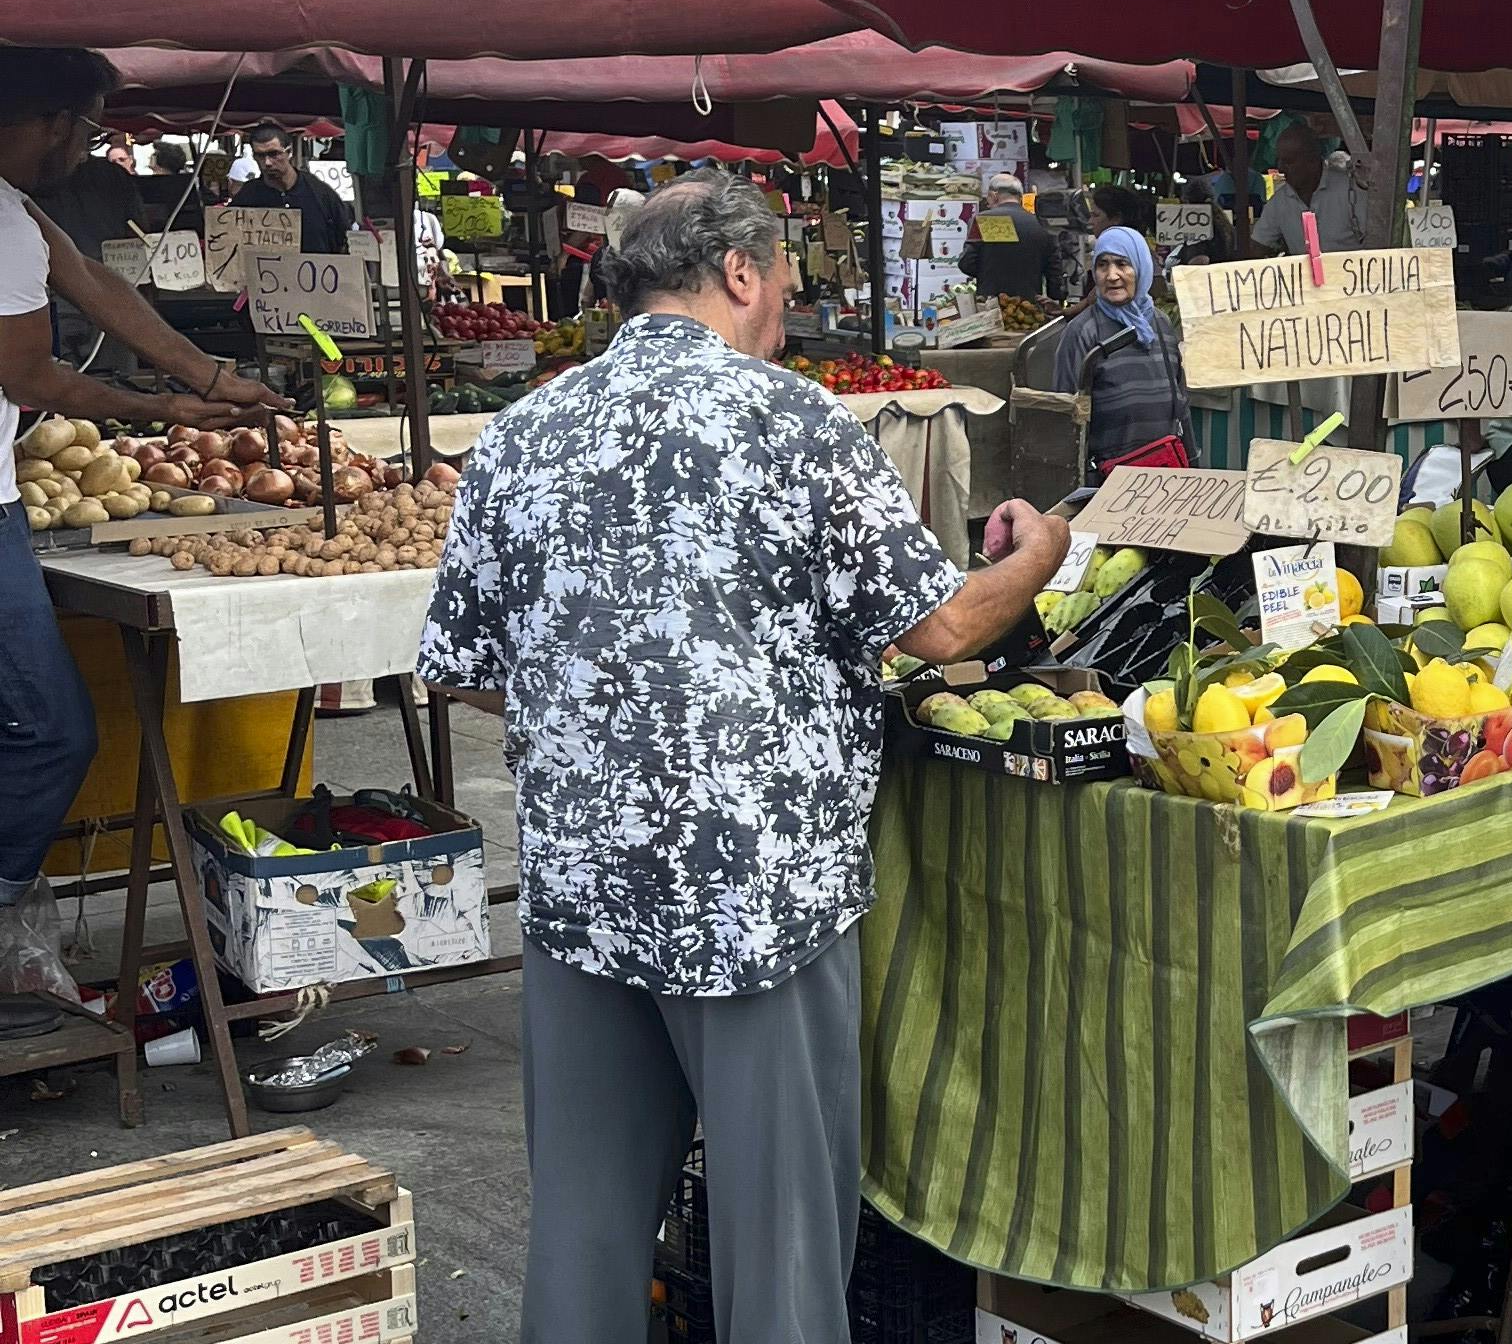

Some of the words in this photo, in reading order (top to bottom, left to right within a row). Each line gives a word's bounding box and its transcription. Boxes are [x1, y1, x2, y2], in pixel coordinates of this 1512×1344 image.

[255, 256, 339, 295] 5.00
[1207, 262, 1305, 316] LIMONI
[1342, 255, 1421, 297] SICILIA
[1239, 308, 1391, 371] NATURALI
[1107, 516, 1189, 545] SICILIA
[1261, 585, 1301, 603] EDIBLE
[1262, 600, 1289, 615] PEEL
[934, 742, 981, 764] SARACENO
[158, 1275, 239, 1315] actel
[1285, 1262, 1392, 1320] Campanale
